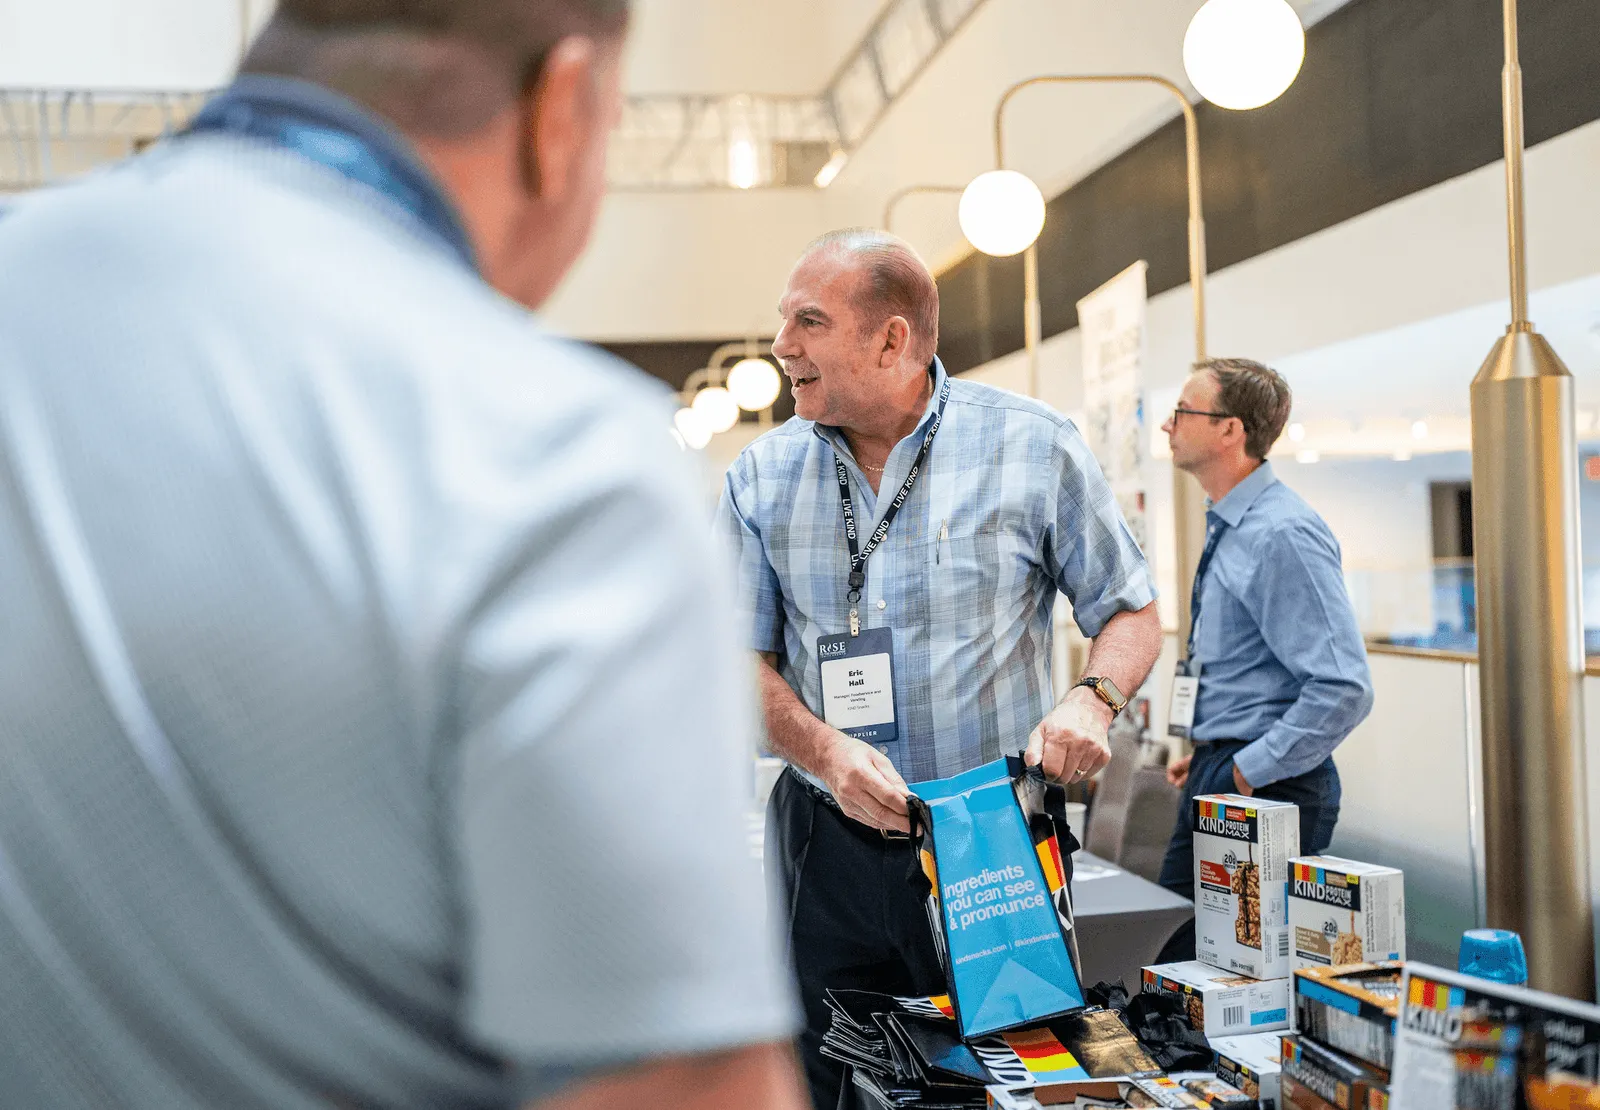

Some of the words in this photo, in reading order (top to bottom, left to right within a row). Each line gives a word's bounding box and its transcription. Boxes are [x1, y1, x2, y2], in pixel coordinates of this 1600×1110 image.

[837, 466, 848, 486] KIND
[892, 488, 908, 508] LIVE
[905, 466, 919, 489] KIND
[842, 498, 853, 517] LIVE
[846, 518, 856, 539] KIND
[860, 542, 876, 560] LIVE
[872, 520, 890, 543] KIND
[1199, 816, 1226, 834] KIND
[1226, 820, 1250, 832] PROTEIN
[1226, 828, 1250, 839] MAX
[1224, 854, 1236, 864] 20g
[944, 865, 1025, 899] ingredients
[1294, 880, 1325, 900] KIND
[1326, 886, 1352, 900] PROTEIN
[946, 895, 972, 918] you
[974, 887, 1002, 904] can
[1004, 880, 1035, 897] see
[1326, 896, 1352, 907] MAX
[950, 918, 958, 930] &
[1324, 921, 1337, 933] 20g
[955, 944, 1007, 964] kindsnacks.com
[1014, 932, 1060, 947] @kindsnacks
[1404, 1005, 1462, 1042] KIND
